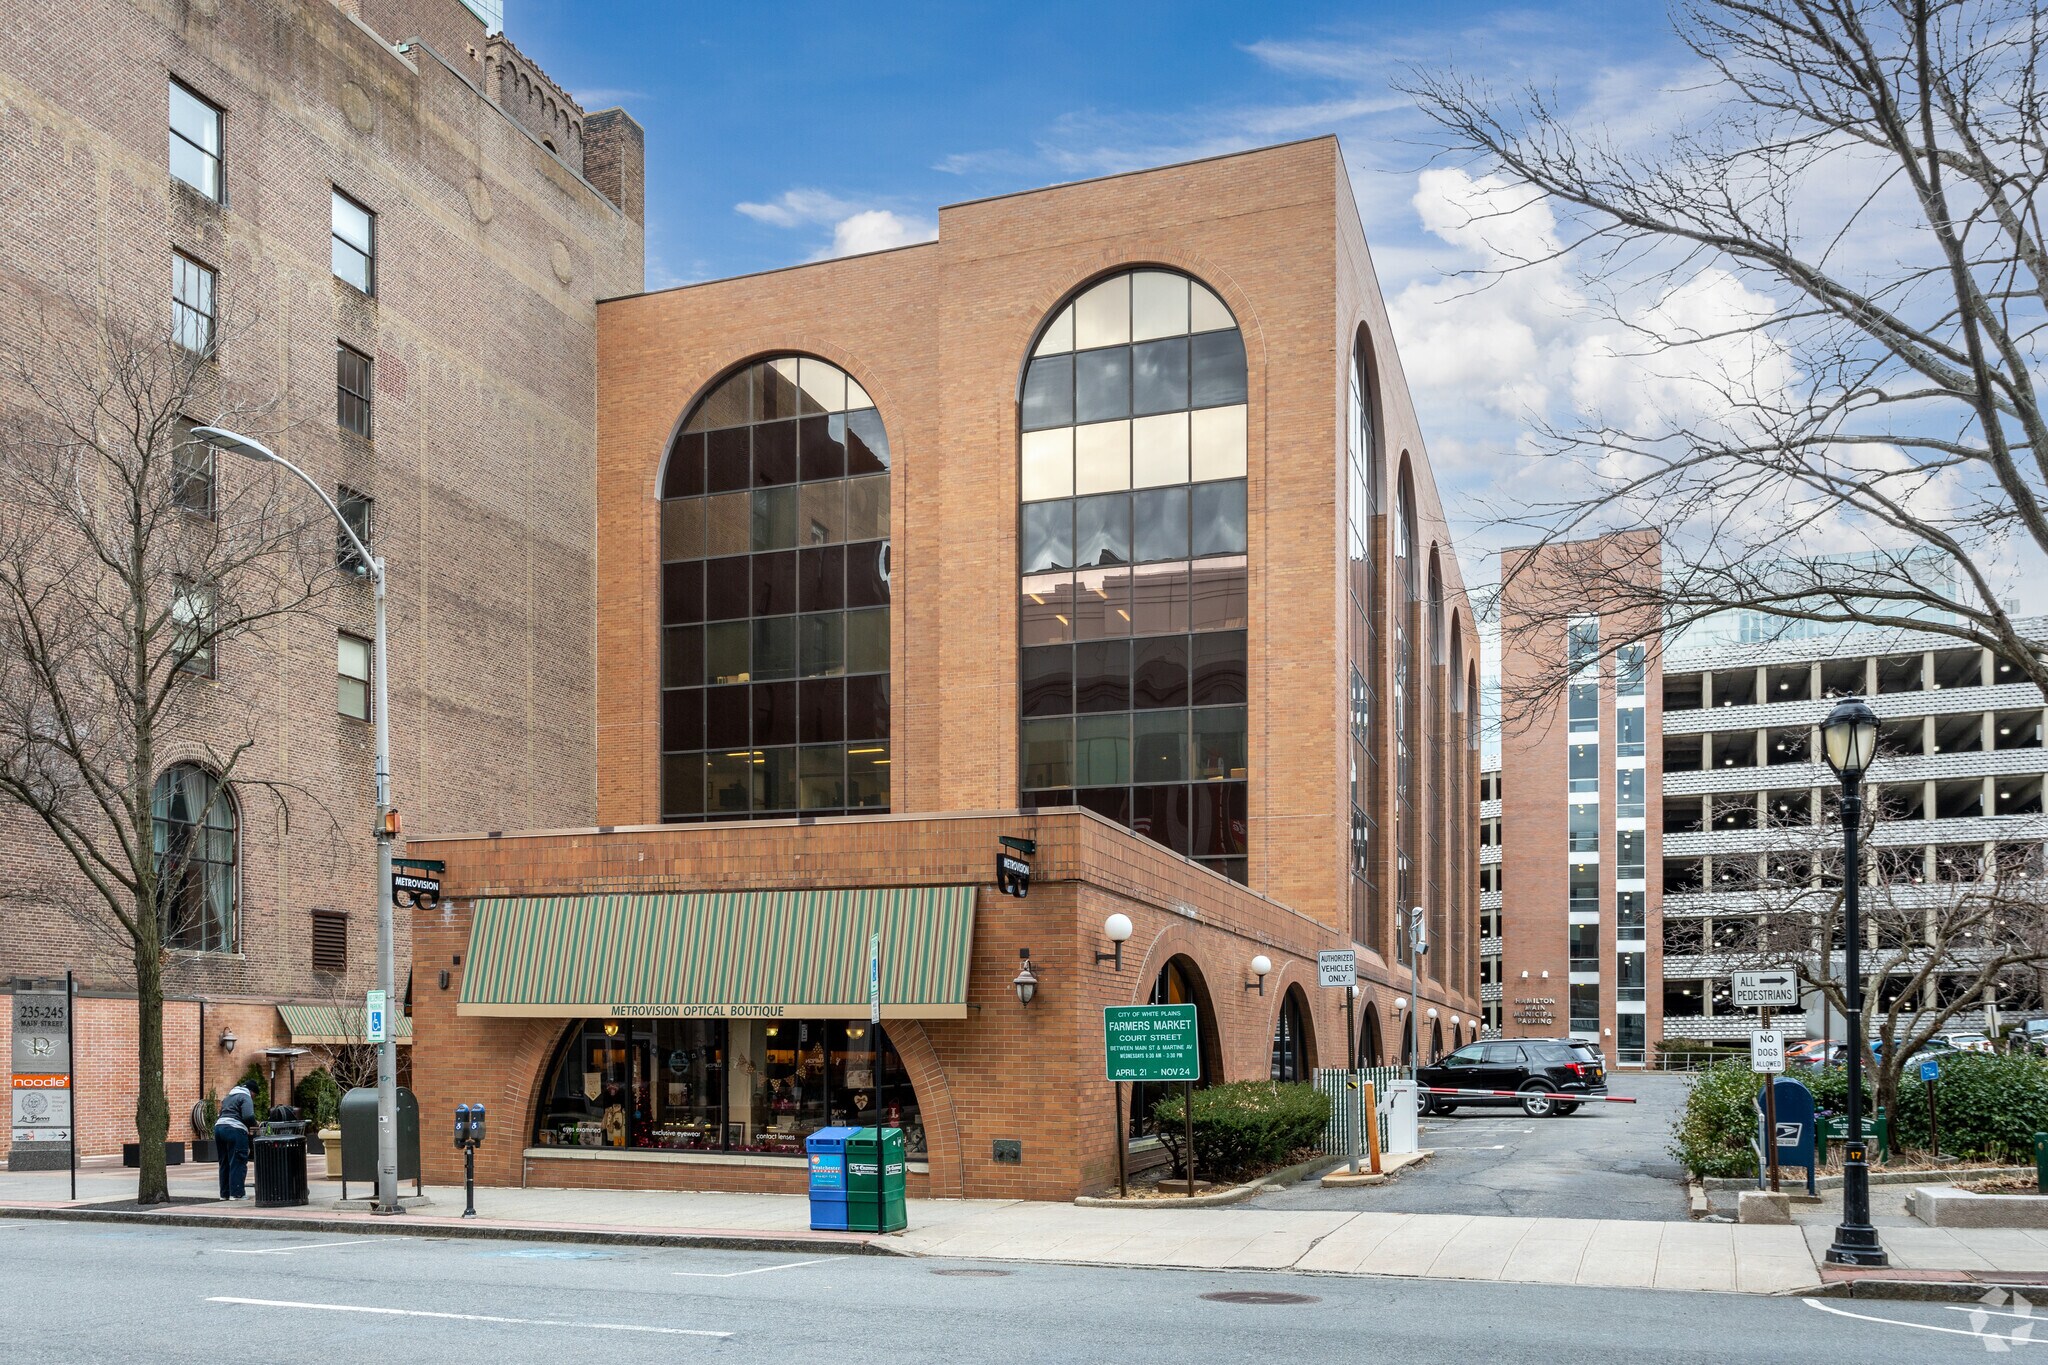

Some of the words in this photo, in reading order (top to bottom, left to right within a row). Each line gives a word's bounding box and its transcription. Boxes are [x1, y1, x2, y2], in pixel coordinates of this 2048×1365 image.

[395, 876, 439, 890] METROVISION
[1321, 954, 1353, 962] AUTHORIZED
[1740, 977, 1755, 986] ALL
[1738, 990, 1792, 1000] PEDESTRIANS
[21, 1006, 64, 1018] 235-245
[611, 1005, 679, 1016] METROVISION
[683, 1005, 725, 1016] OPTICAL
[730, 1005, 784, 1017] BOUTIQUE
[1109, 1021, 1150, 1031] FARMERS
[1153, 1020, 1191, 1030] MARKET
[1150, 1033, 1182, 1041] STREET
[1760, 1035, 1774, 1043] NO
[1758, 1048, 1778, 1056] DOGS
[1161, 1068, 1178, 1076] NOV
[562, 1126, 575, 1134] eyes
[576, 1126, 601, 1134] examined
[778, 1133, 796, 1141] lenses
[1850, 1151, 1861, 1159] 17
